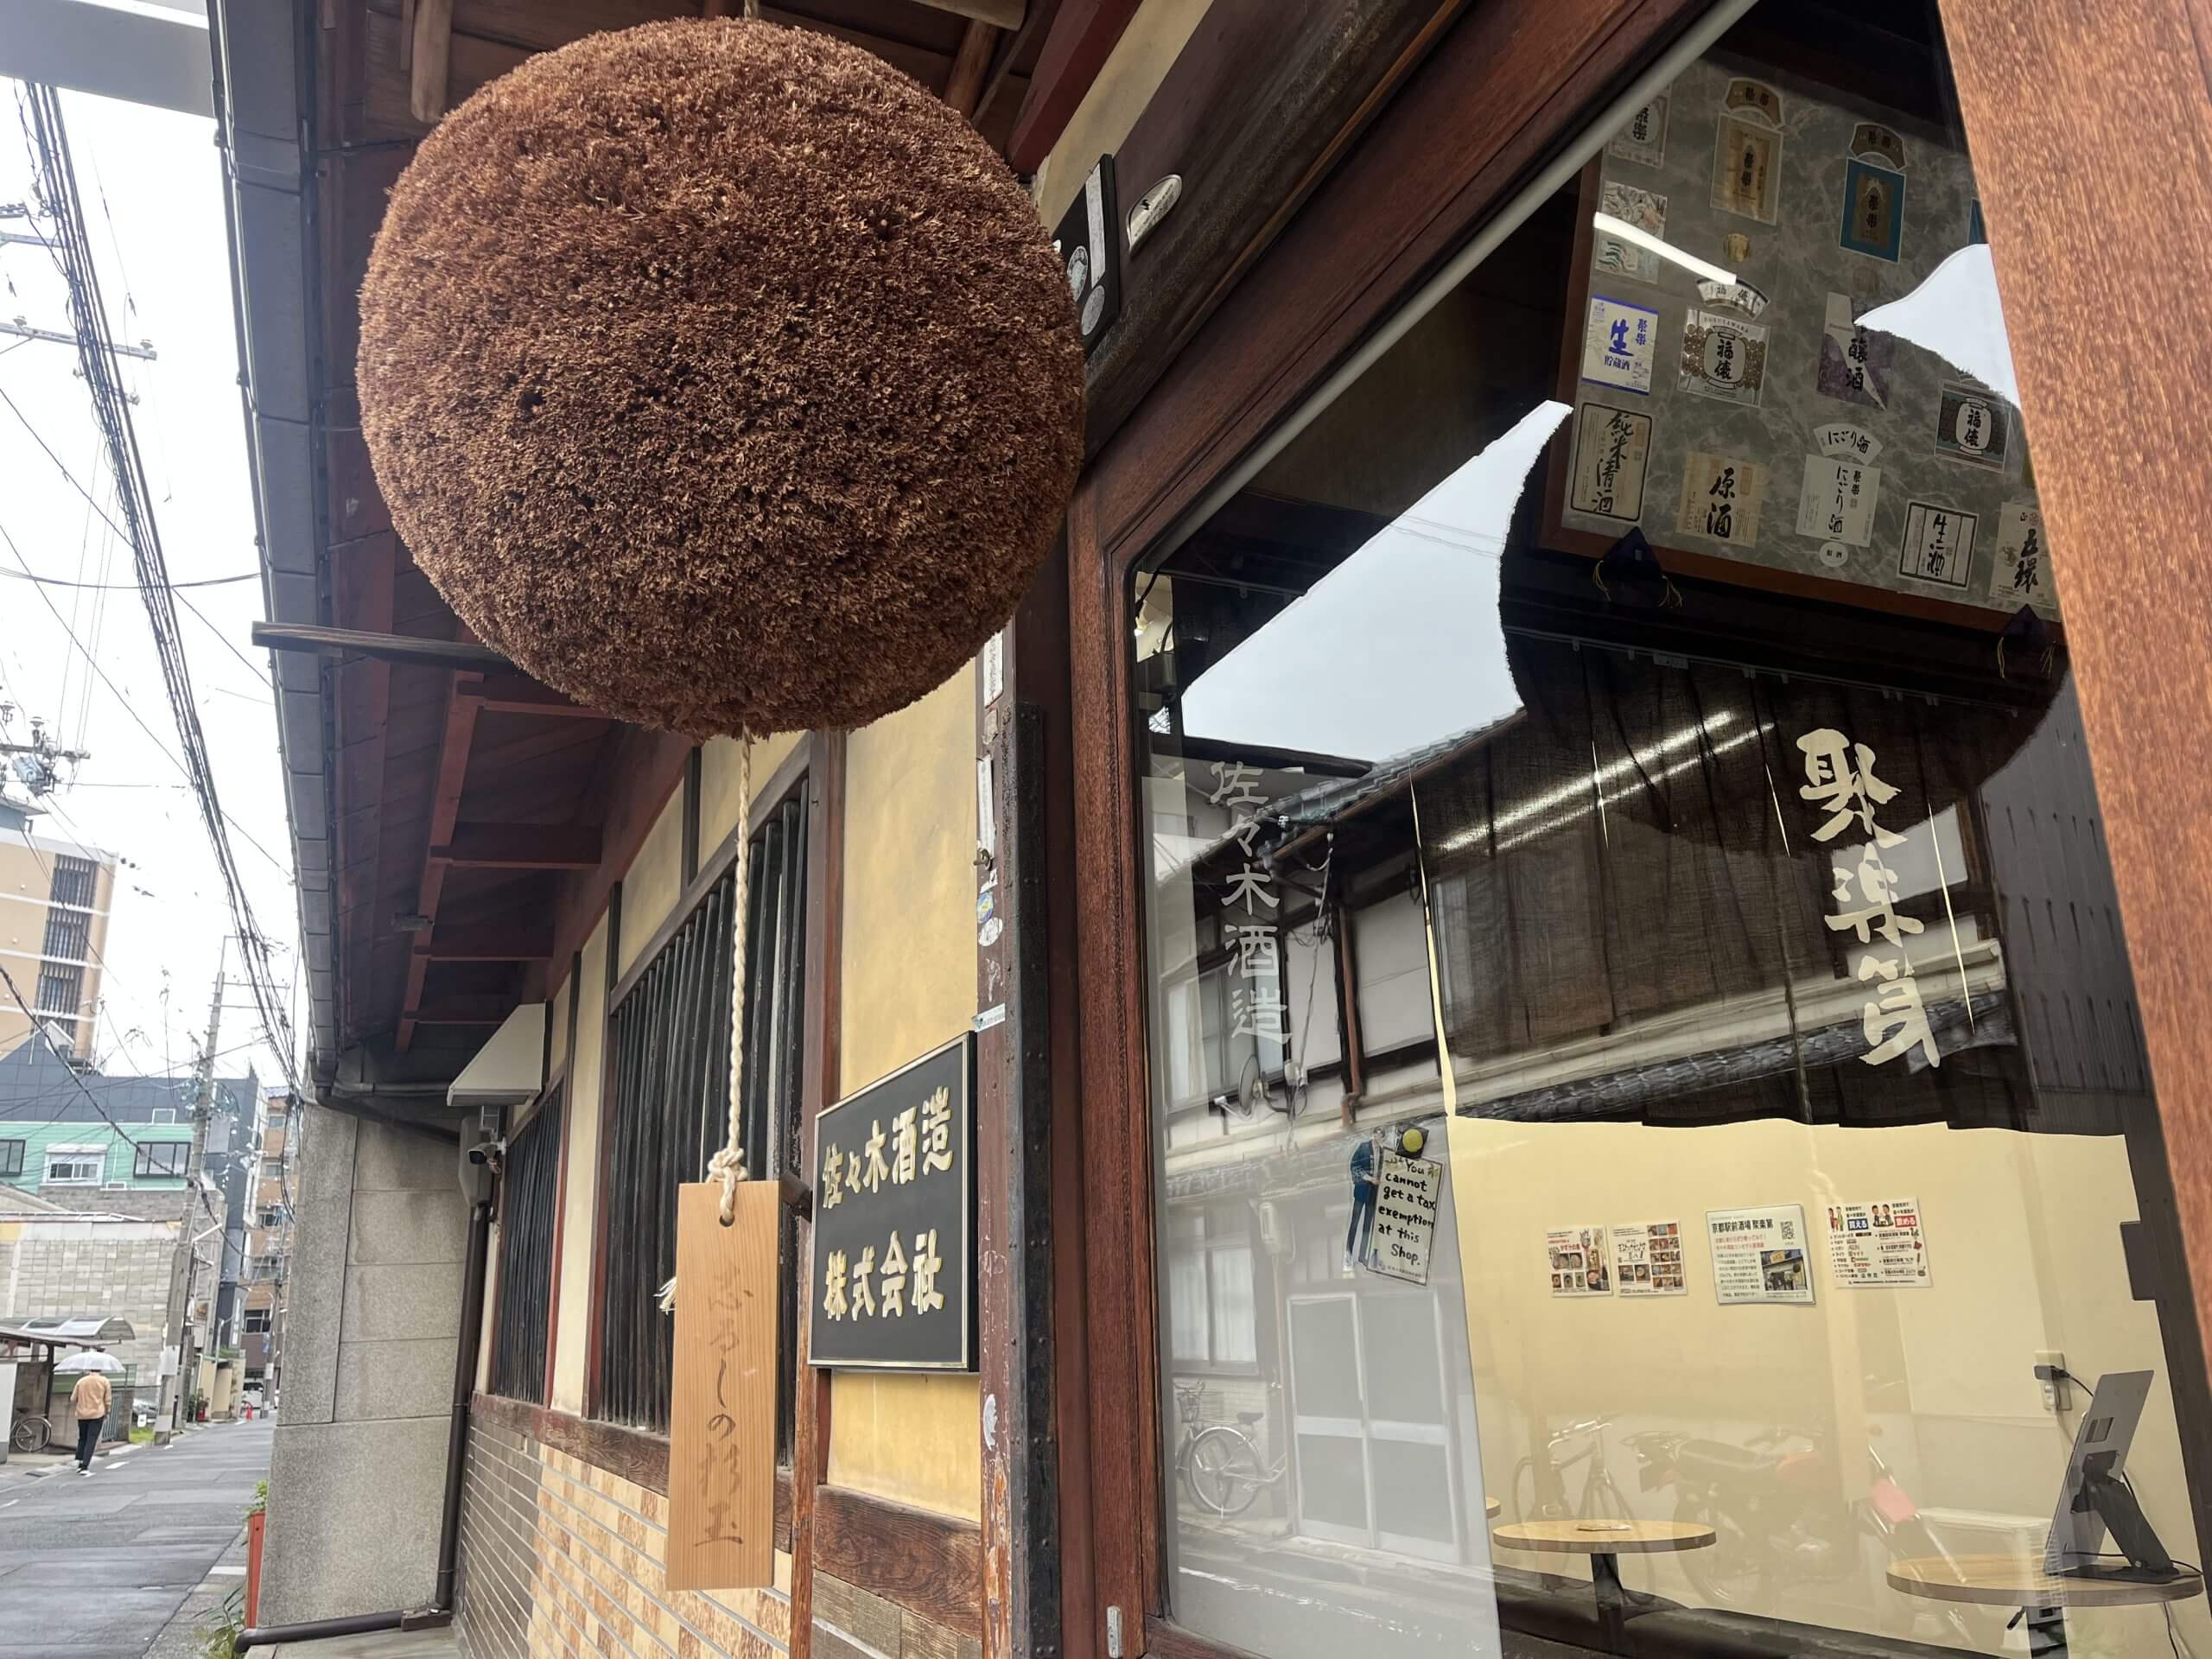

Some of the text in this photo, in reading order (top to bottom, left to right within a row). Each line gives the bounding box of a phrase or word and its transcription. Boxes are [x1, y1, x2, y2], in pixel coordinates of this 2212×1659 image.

[1609, 318, 1634, 357] 生
[1827, 430, 1871, 454] にごり酒
[1707, 467, 1735, 538] 原酒
[1828, 465, 1848, 533] にごり酒
[1210, 760, 1293, 1045] 佐々木酒造
[822, 1085, 953, 1210] 佐々木酒造
[1405, 1160, 1425, 1175] You
[1385, 1172, 1427, 1192] cannot
[1382, 1185, 1436, 1211] get a tax
[1377, 1205, 1434, 1230] exemption
[1712, 1219, 1751, 1235] 京都駅前酒場
[1377, 1223, 1420, 1243] at this
[1391, 1243, 1421, 1266] Shop.
[823, 1228, 944, 1322] 株式会社
